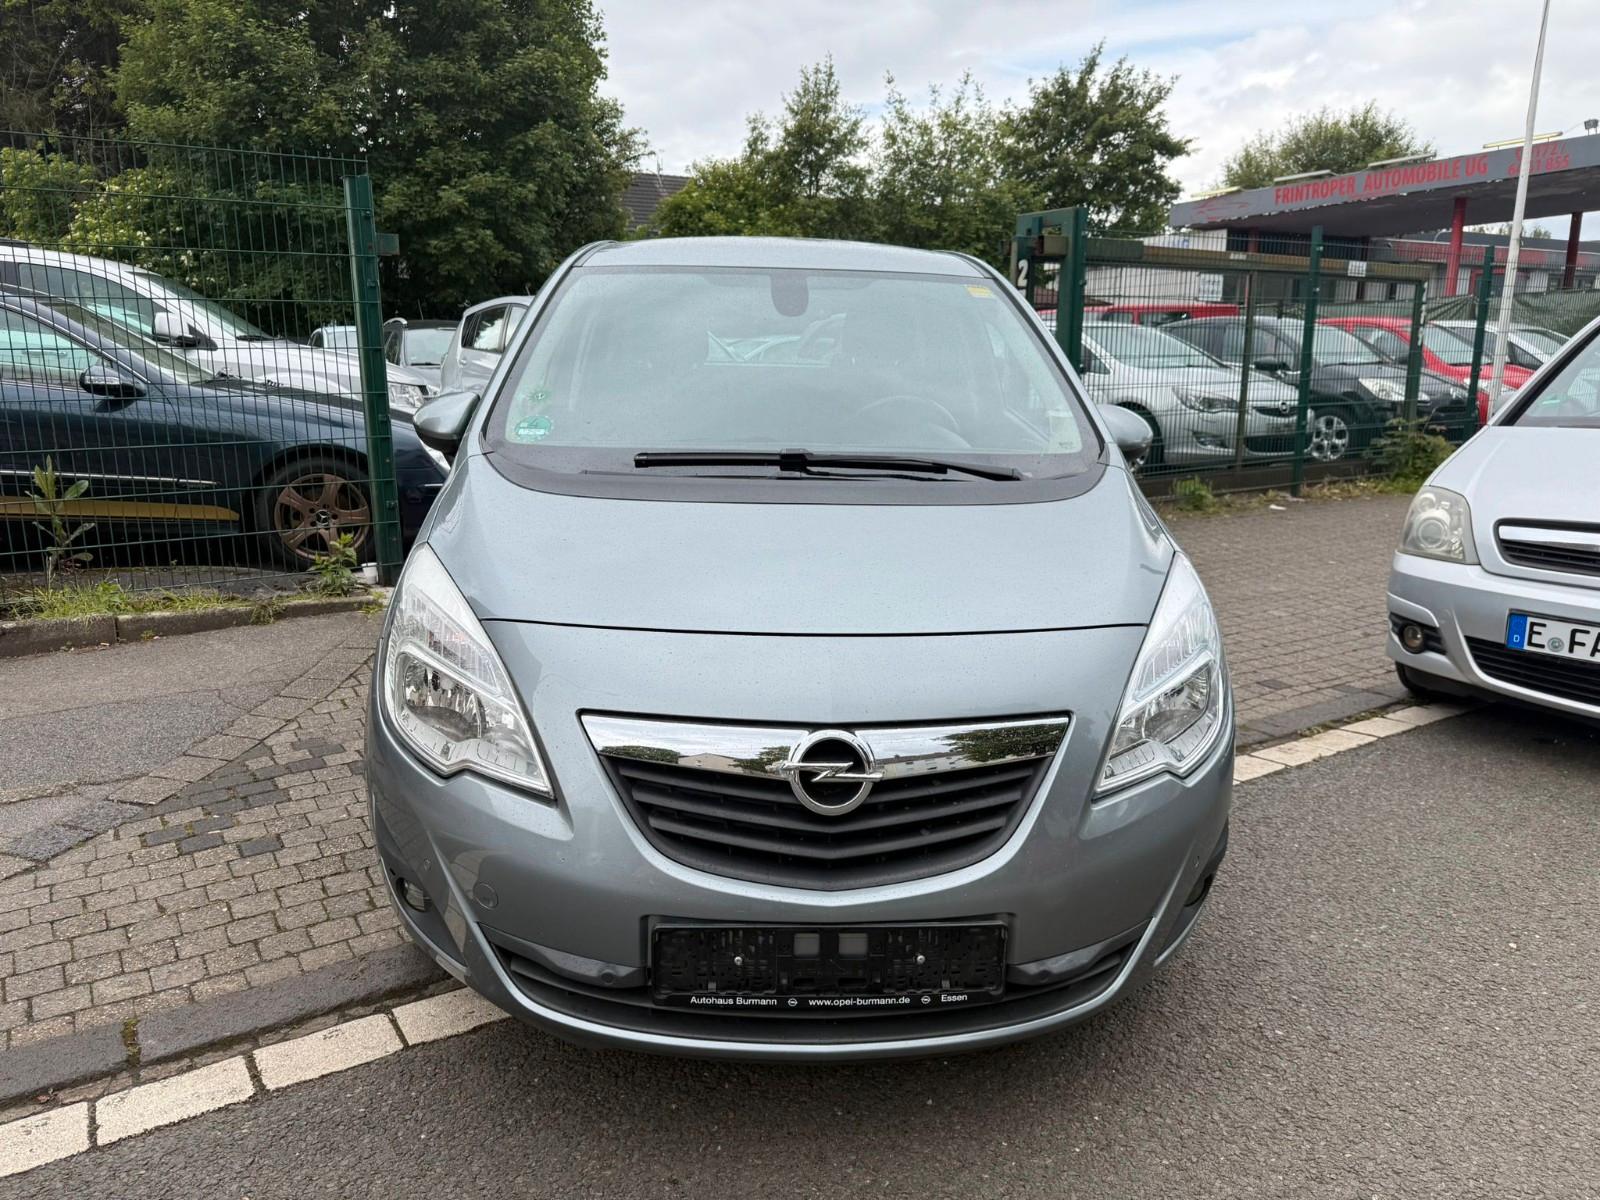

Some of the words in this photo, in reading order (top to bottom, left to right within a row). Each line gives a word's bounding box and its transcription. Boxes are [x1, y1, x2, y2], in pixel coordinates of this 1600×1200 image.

[1274, 175, 1355, 205] FRINTROPER
[1363, 160, 1460, 193] AUTOMOBILE
[1465, 155, 1489, 177] UG
[1017, 258, 1029, 288] 2
[1513, 634, 1520, 643] D
[1527, 621, 1547, 649] E
[690, 995, 734, 1005] Autohaus
[736, 996, 777, 1006] Burmann
[808, 996, 911, 1007] www.opel-burmann.de
[940, 993, 968, 1003] Essen
